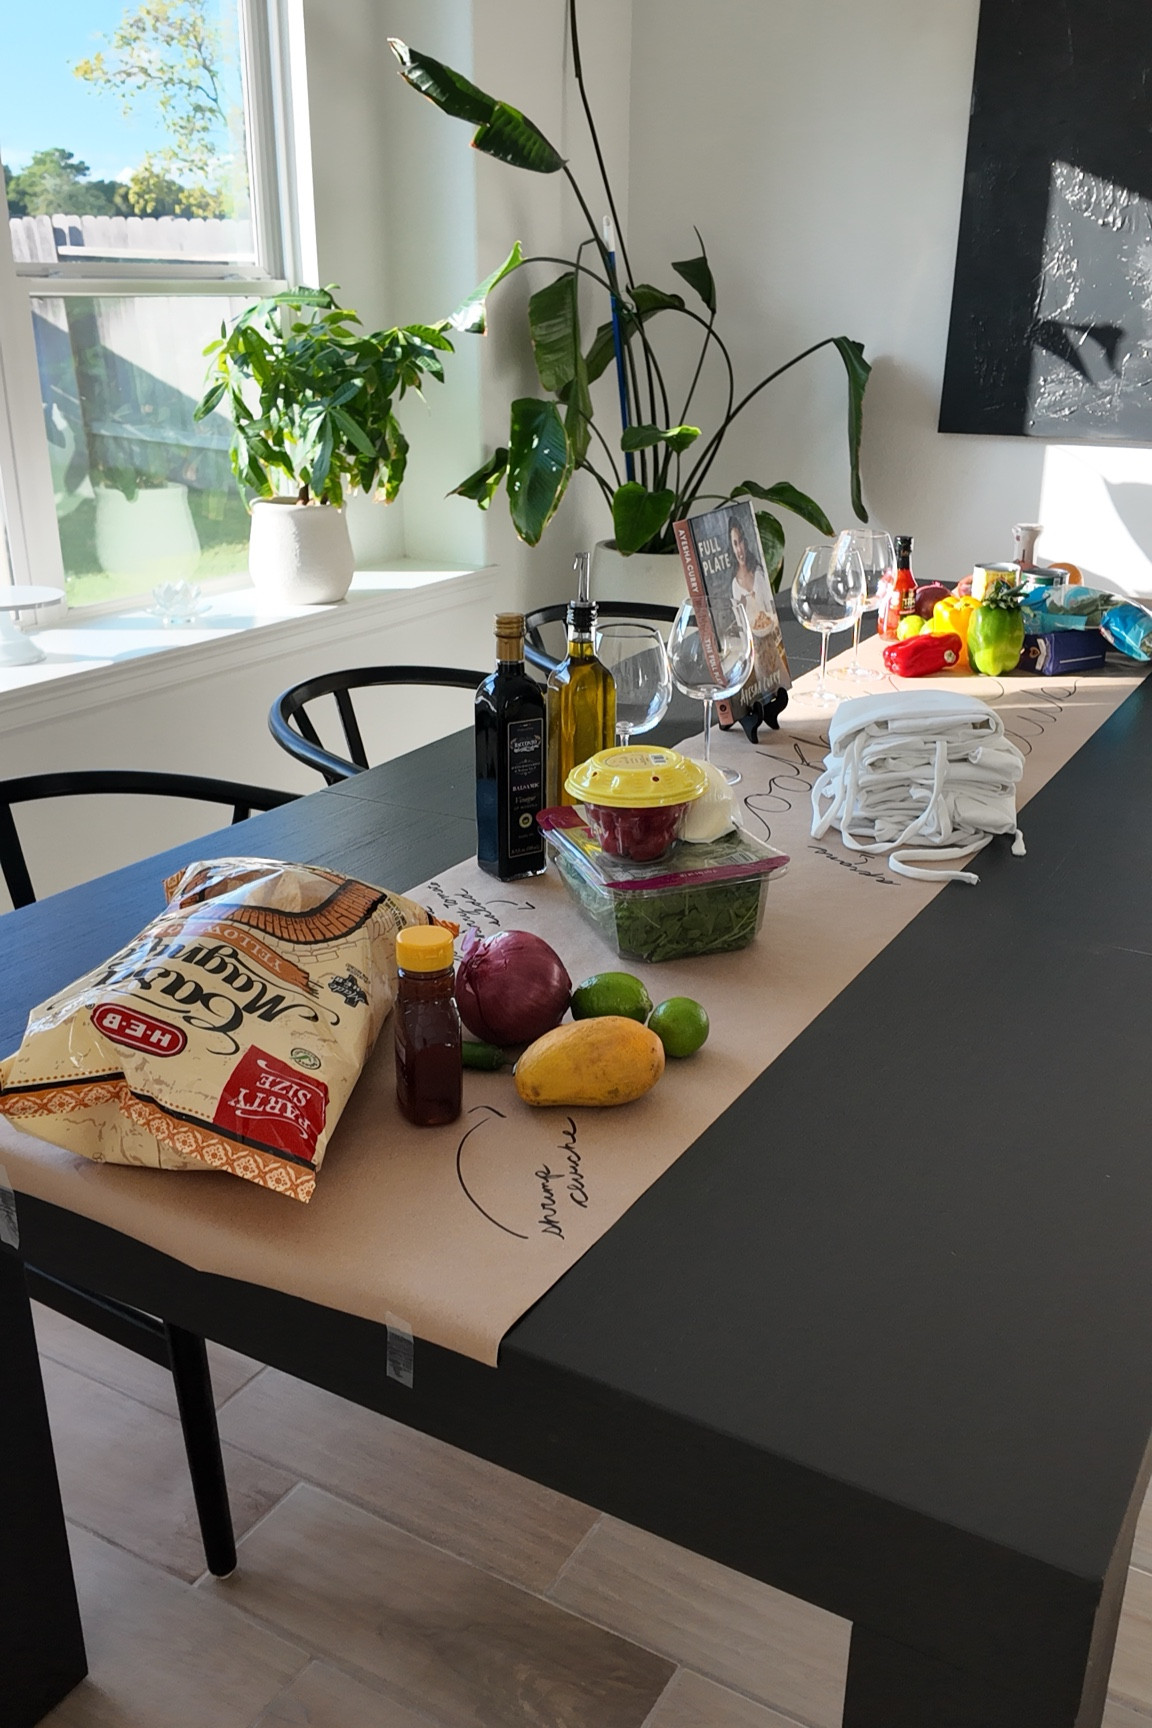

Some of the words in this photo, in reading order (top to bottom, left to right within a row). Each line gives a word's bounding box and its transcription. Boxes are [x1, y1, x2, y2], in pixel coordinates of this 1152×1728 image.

[678, 529, 692, 564] AYESHA
[686, 564, 699, 593] CURRY
[698, 537, 721, 558] FULL
[702, 553, 731, 577] PLATE
[256, 1073, 312, 1107] SIZE
[227, 1087, 311, 1130] PARTY
